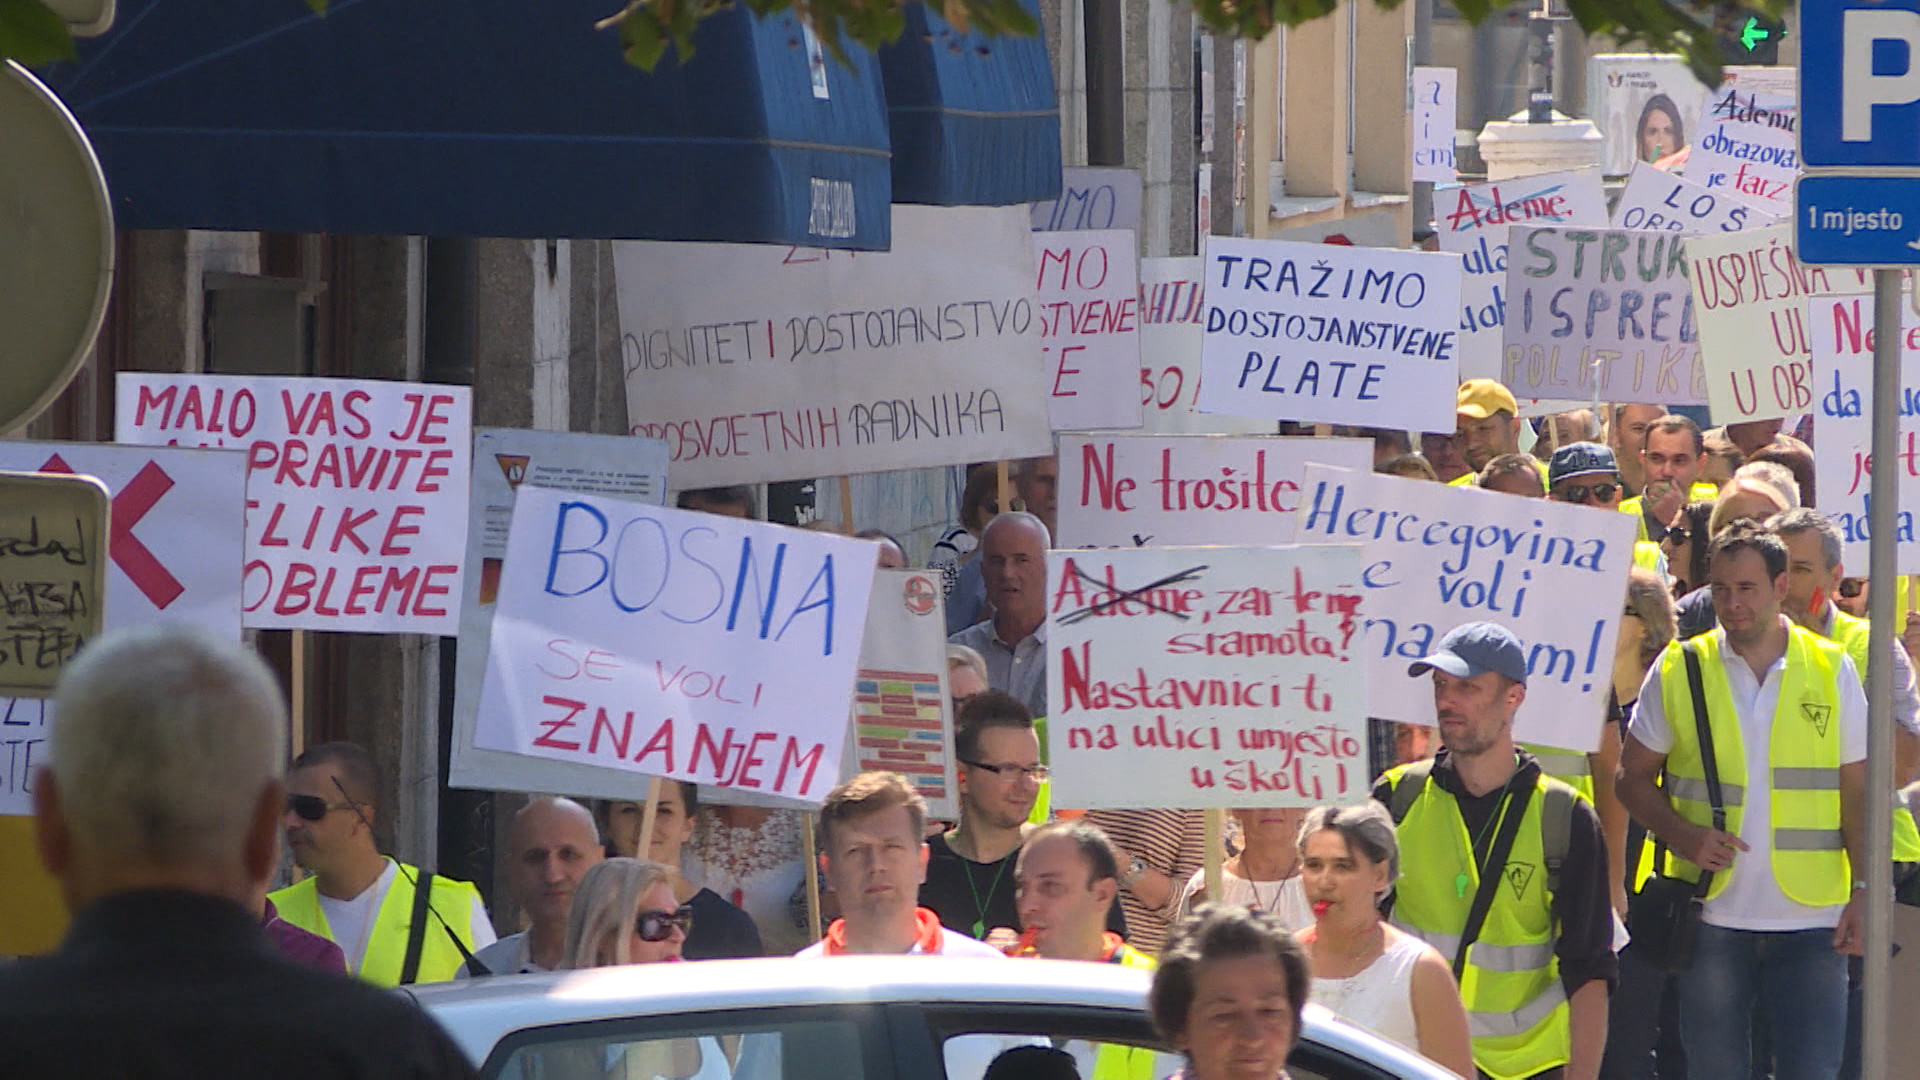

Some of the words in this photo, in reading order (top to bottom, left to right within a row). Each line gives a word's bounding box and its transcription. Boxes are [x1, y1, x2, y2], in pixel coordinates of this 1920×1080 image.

[1842, 9, 1920, 142] P
[1702, 124, 1799, 169] obrazova
[1808, 205, 1818, 228] 1
[1822, 207, 1904, 236] mjesto
[1216, 255, 1426, 309] TRAŽIMO
[1462, 236, 1509, 275] ula
[1524, 227, 1691, 283] STRUK
[622, 321, 758, 379] DIGNITET
[767, 319, 775, 359] I
[786, 297, 1032, 362] DOSTOJANSTVO
[1206, 306, 1457, 361] DOSTOJANSTVENE
[1238, 350, 1387, 400] PLATE
[1772, 360, 1813, 412] OB
[1822, 368, 1862, 418] da
[134, 384, 257, 438] MALO
[281, 388, 372, 441] VAS
[390, 393, 455, 445] JE
[848, 388, 1005, 446] RADNIKA
[247, 440, 454, 493] PRAVITE
[1080, 443, 1137, 513] Ne
[246, 499, 426, 557] LIKE
[1305, 480, 1607, 575] Hercegovina
[243, 558, 459, 617] OBLEME
[544, 501, 836, 657] BOSNA
[1216, 585, 1282, 617] zar
[1438, 558, 1533, 619] voli
[1164, 619, 1357, 663] sramota?
[534, 638, 624, 683] SE
[654, 658, 764, 708] VOLI
[1060, 639, 1281, 715] Nastavnici
[1290, 673, 1333, 713] ti
[532, 694, 825, 796] ZNANJEM
[1068, 724, 1120, 750] na
[1133, 714, 1221, 750] ulici
[1238, 720, 1361, 770] umjesto
[1190, 766, 1215, 789] u
